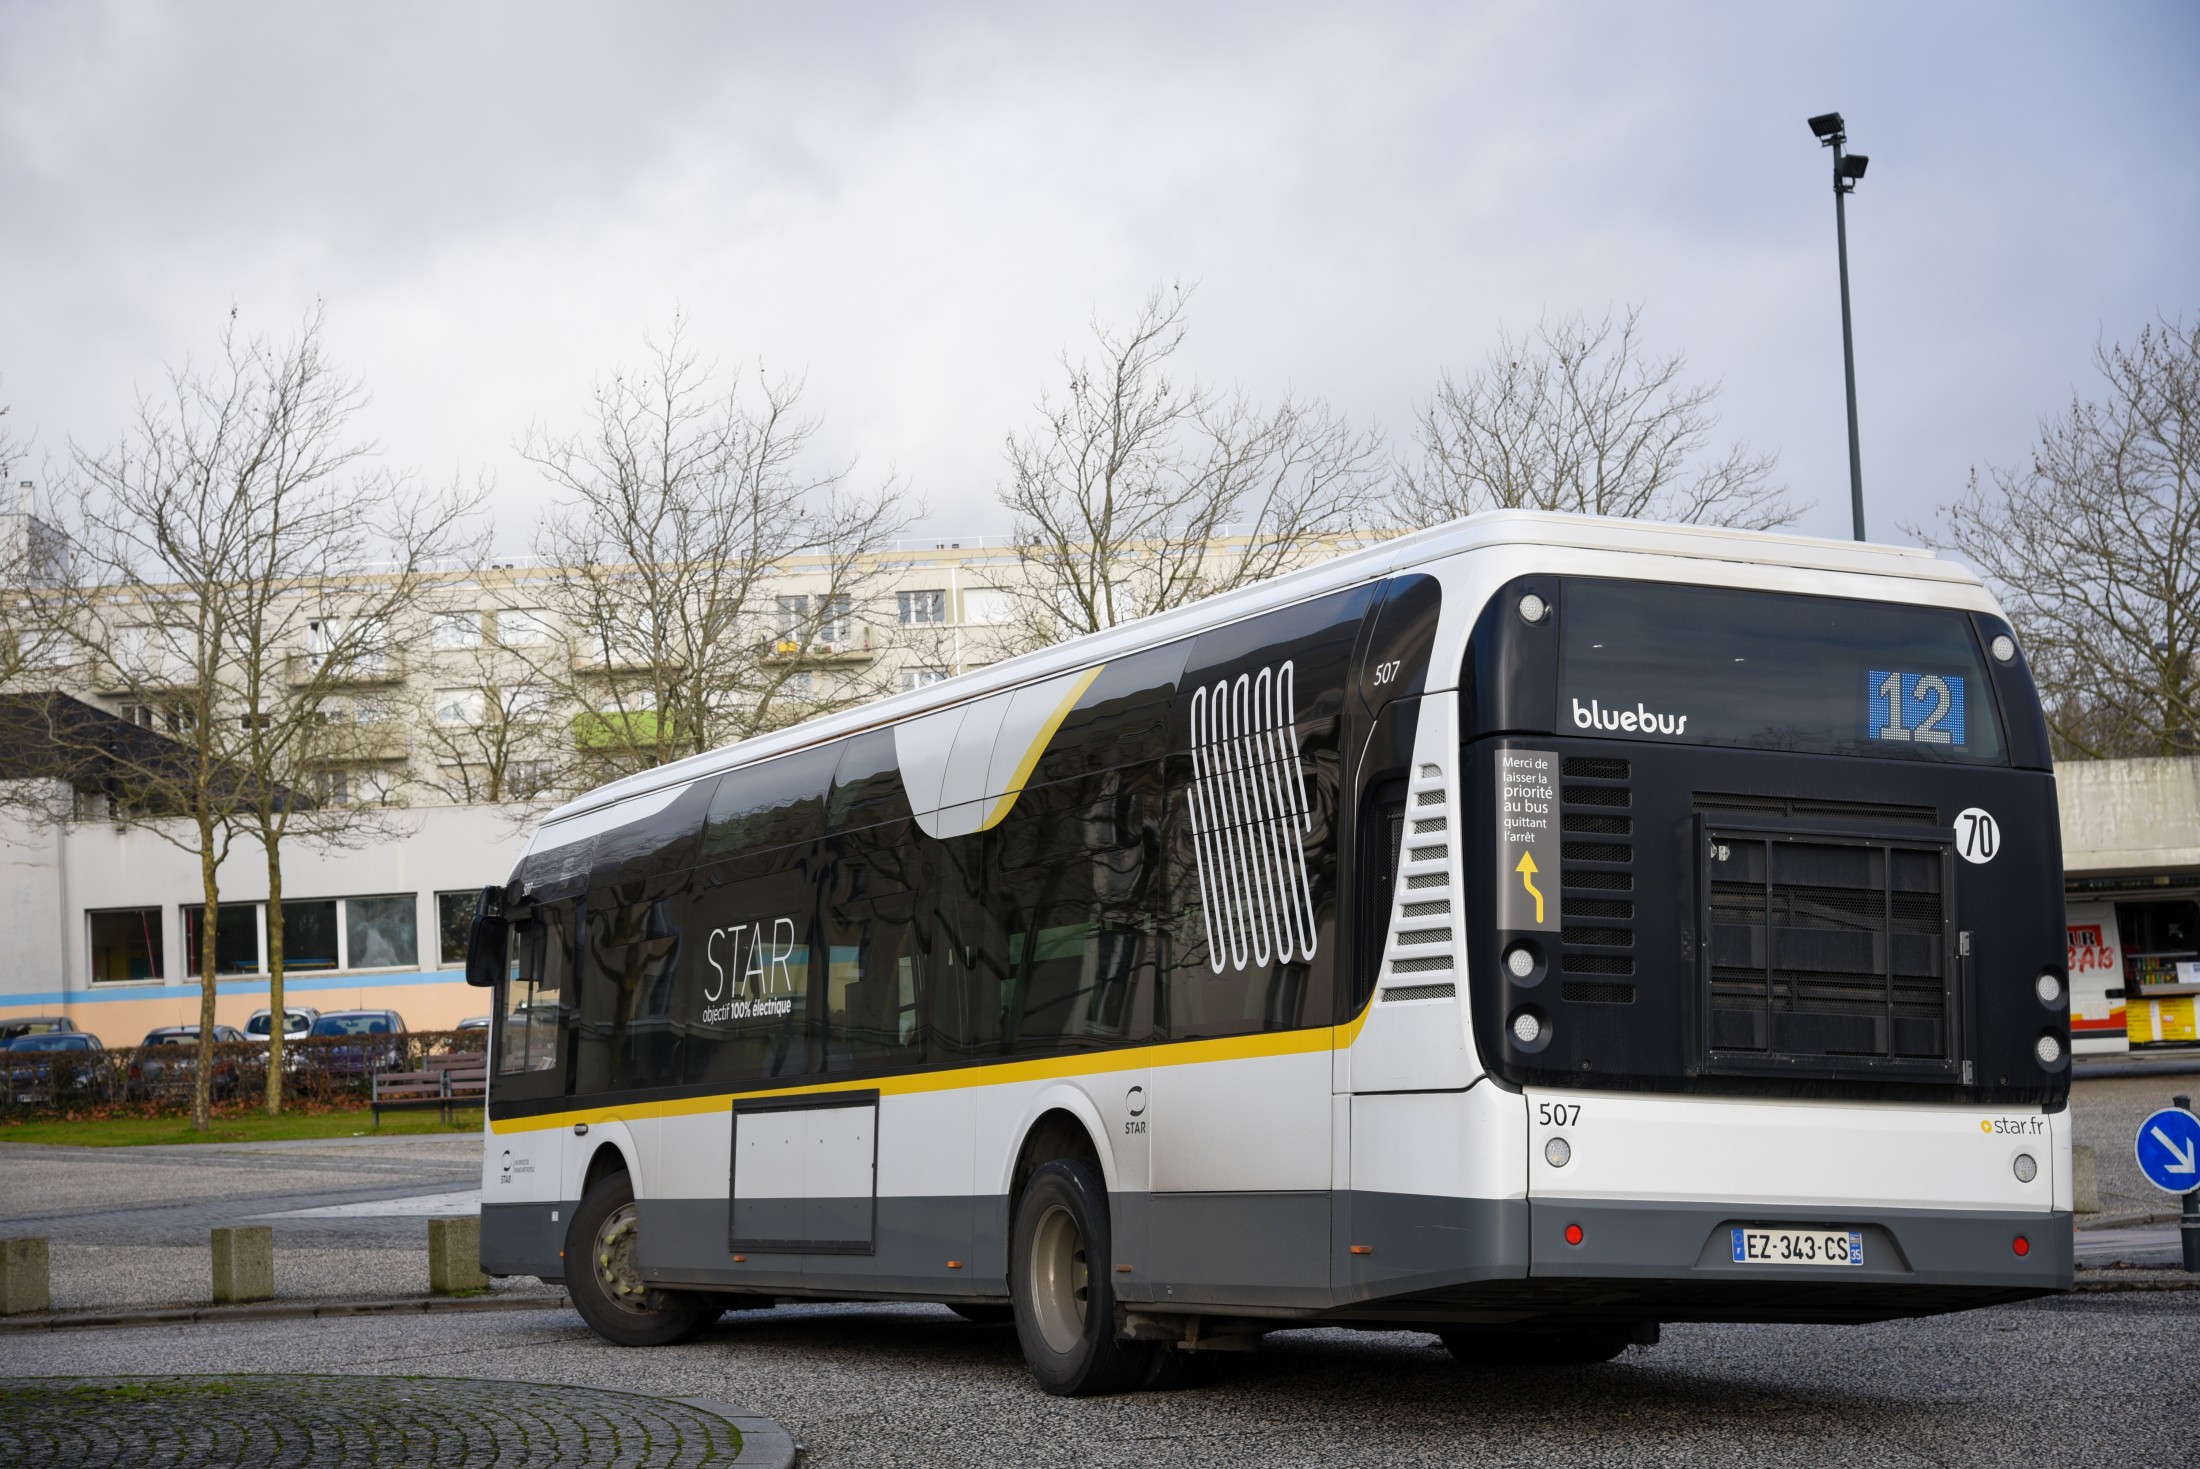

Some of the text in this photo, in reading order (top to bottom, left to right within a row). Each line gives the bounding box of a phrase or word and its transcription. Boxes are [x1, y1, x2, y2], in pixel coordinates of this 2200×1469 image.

[1373, 660, 1401, 686] 507
[1572, 697, 1687, 736] bluebus
[1880, 672, 1951, 744] 12
[1502, 756, 1549, 770] Merci de
[1503, 771, 1548, 784] laisser la
[1503, 784, 1553, 800] priorité
[1503, 798, 1549, 814] au bus
[1503, 816, 1547, 829] quittant
[1504, 830, 1536, 843] l'arrêt
[1963, 814, 1994, 858] 70
[704, 917, 795, 1002] STAR
[702, 996, 792, 1025] objectif 100% électrique
[1539, 1102, 1581, 1127] 507
[1125, 1121, 1146, 1135] STAR
[1994, 1116, 2044, 1135] star.fr
[500, 1174, 512, 1185] STAR
[1736, 1234, 1861, 1261] F EZ-343-CS 35
